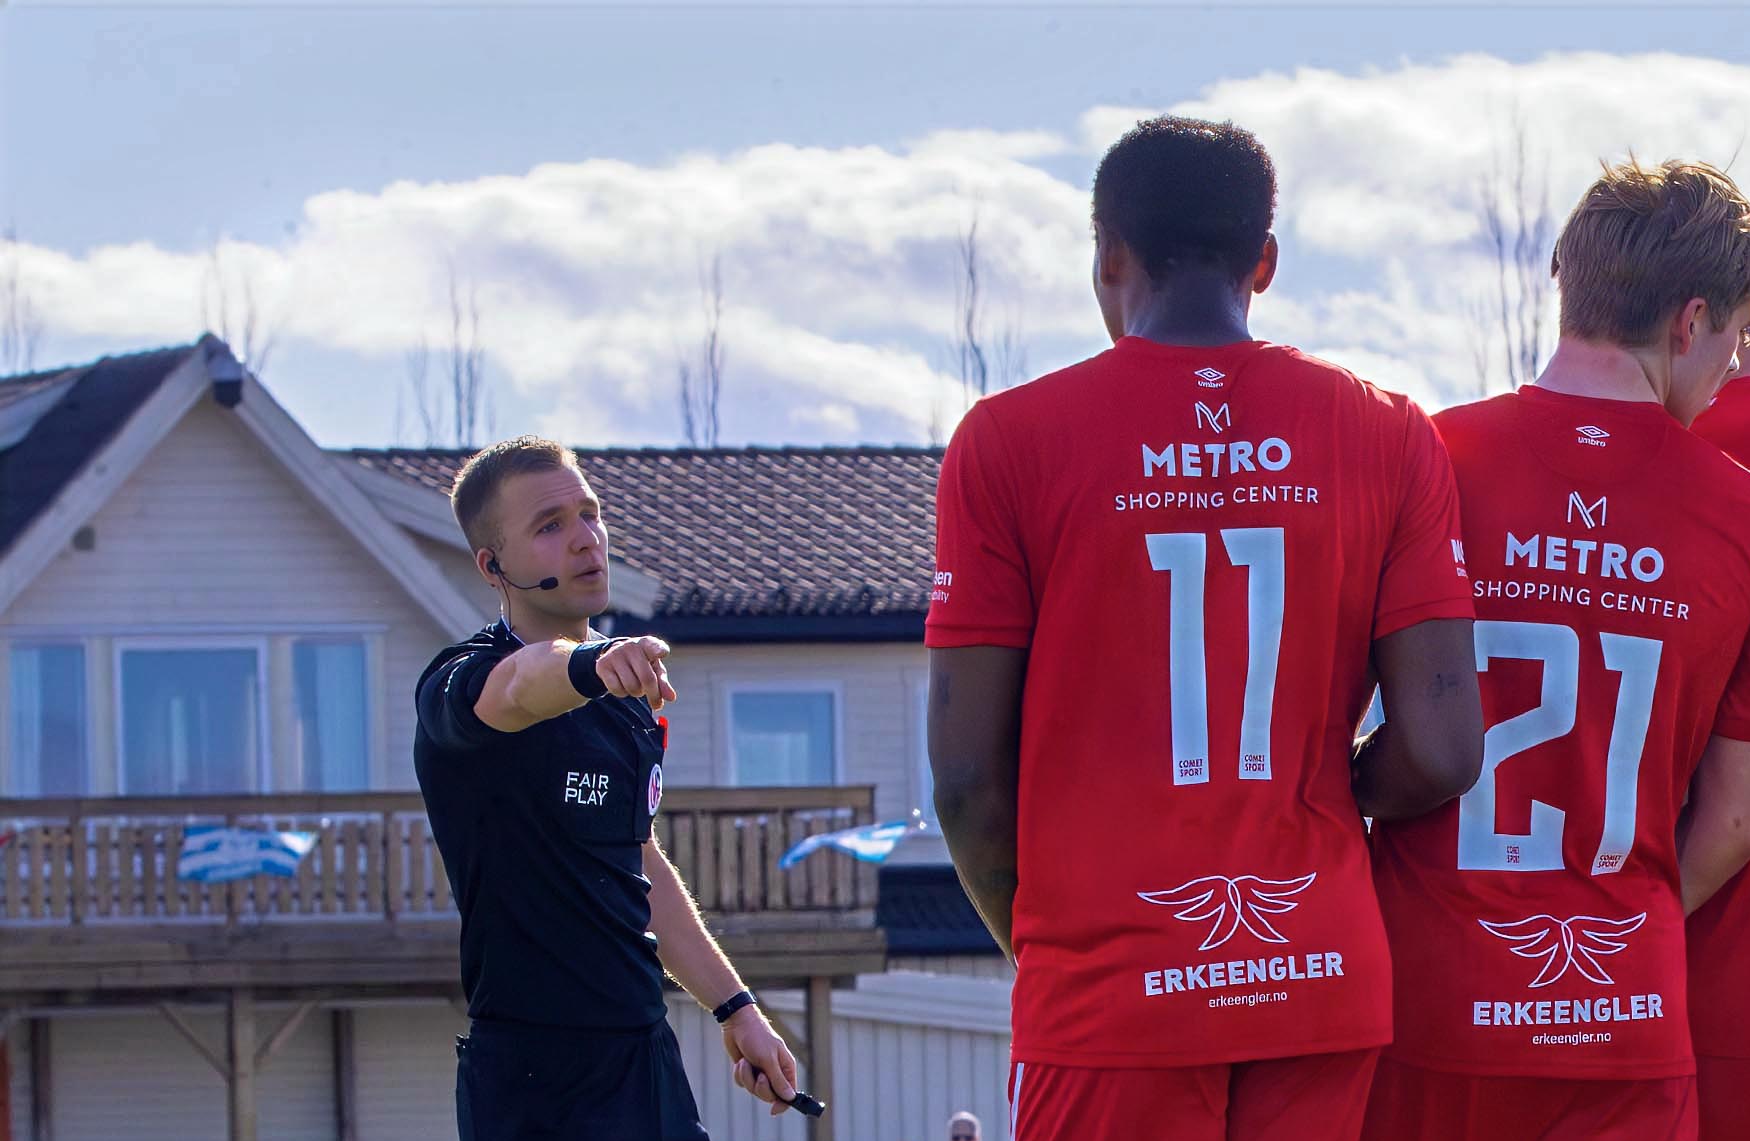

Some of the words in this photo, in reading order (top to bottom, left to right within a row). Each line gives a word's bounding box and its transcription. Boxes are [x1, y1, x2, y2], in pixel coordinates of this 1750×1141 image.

[1577, 436, 1606, 448] umbro
[1142, 437, 1291, 478] METRO
[1115, 492, 1224, 511] SHOPPING
[1232, 486, 1319, 504] CENTER
[1505, 532, 1665, 583] METRO
[1473, 580, 1591, 606] SHOPPING
[1600, 591, 1690, 620] CENTER
[1145, 527, 1285, 785] 11
[1457, 620, 1663, 876] 21
[1179, 759, 1203, 769] COMET
[1180, 768, 1203, 777] SPORT
[566, 771, 609, 790] FAIR
[564, 787, 608, 806] PLAY
[1144, 952, 1344, 996] ERKEENGLER
[1208, 991, 1288, 1008] erkeengler.no
[1473, 994, 1664, 1026] ERKEENGLER
[1532, 1031, 1612, 1046] erkeengler.no
